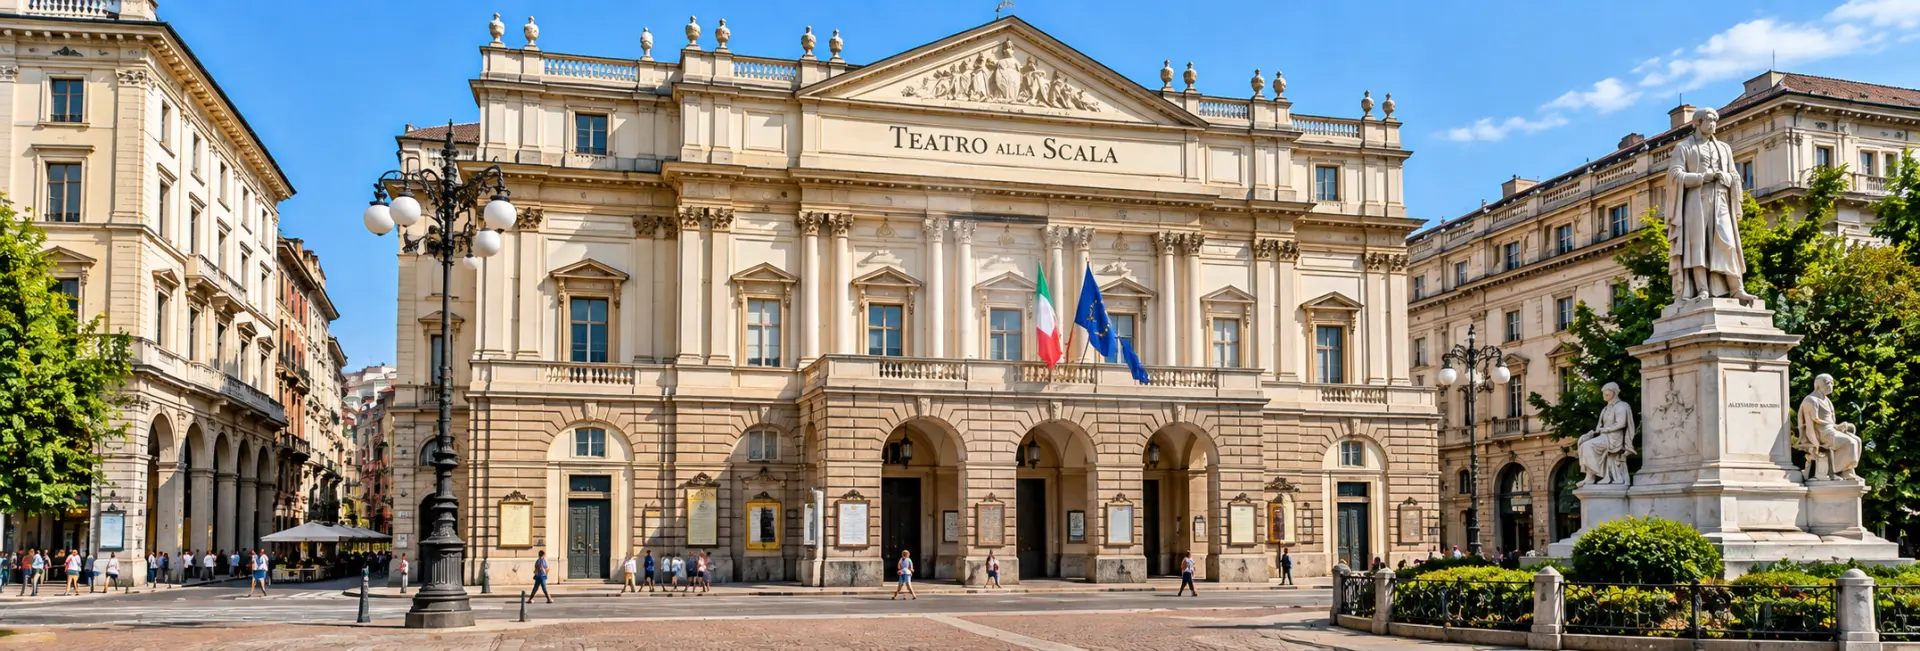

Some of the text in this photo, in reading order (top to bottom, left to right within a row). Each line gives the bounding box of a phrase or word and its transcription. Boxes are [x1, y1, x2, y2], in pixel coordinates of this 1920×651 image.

[889, 125, 1119, 164] TEATRO ALLA SCALA
